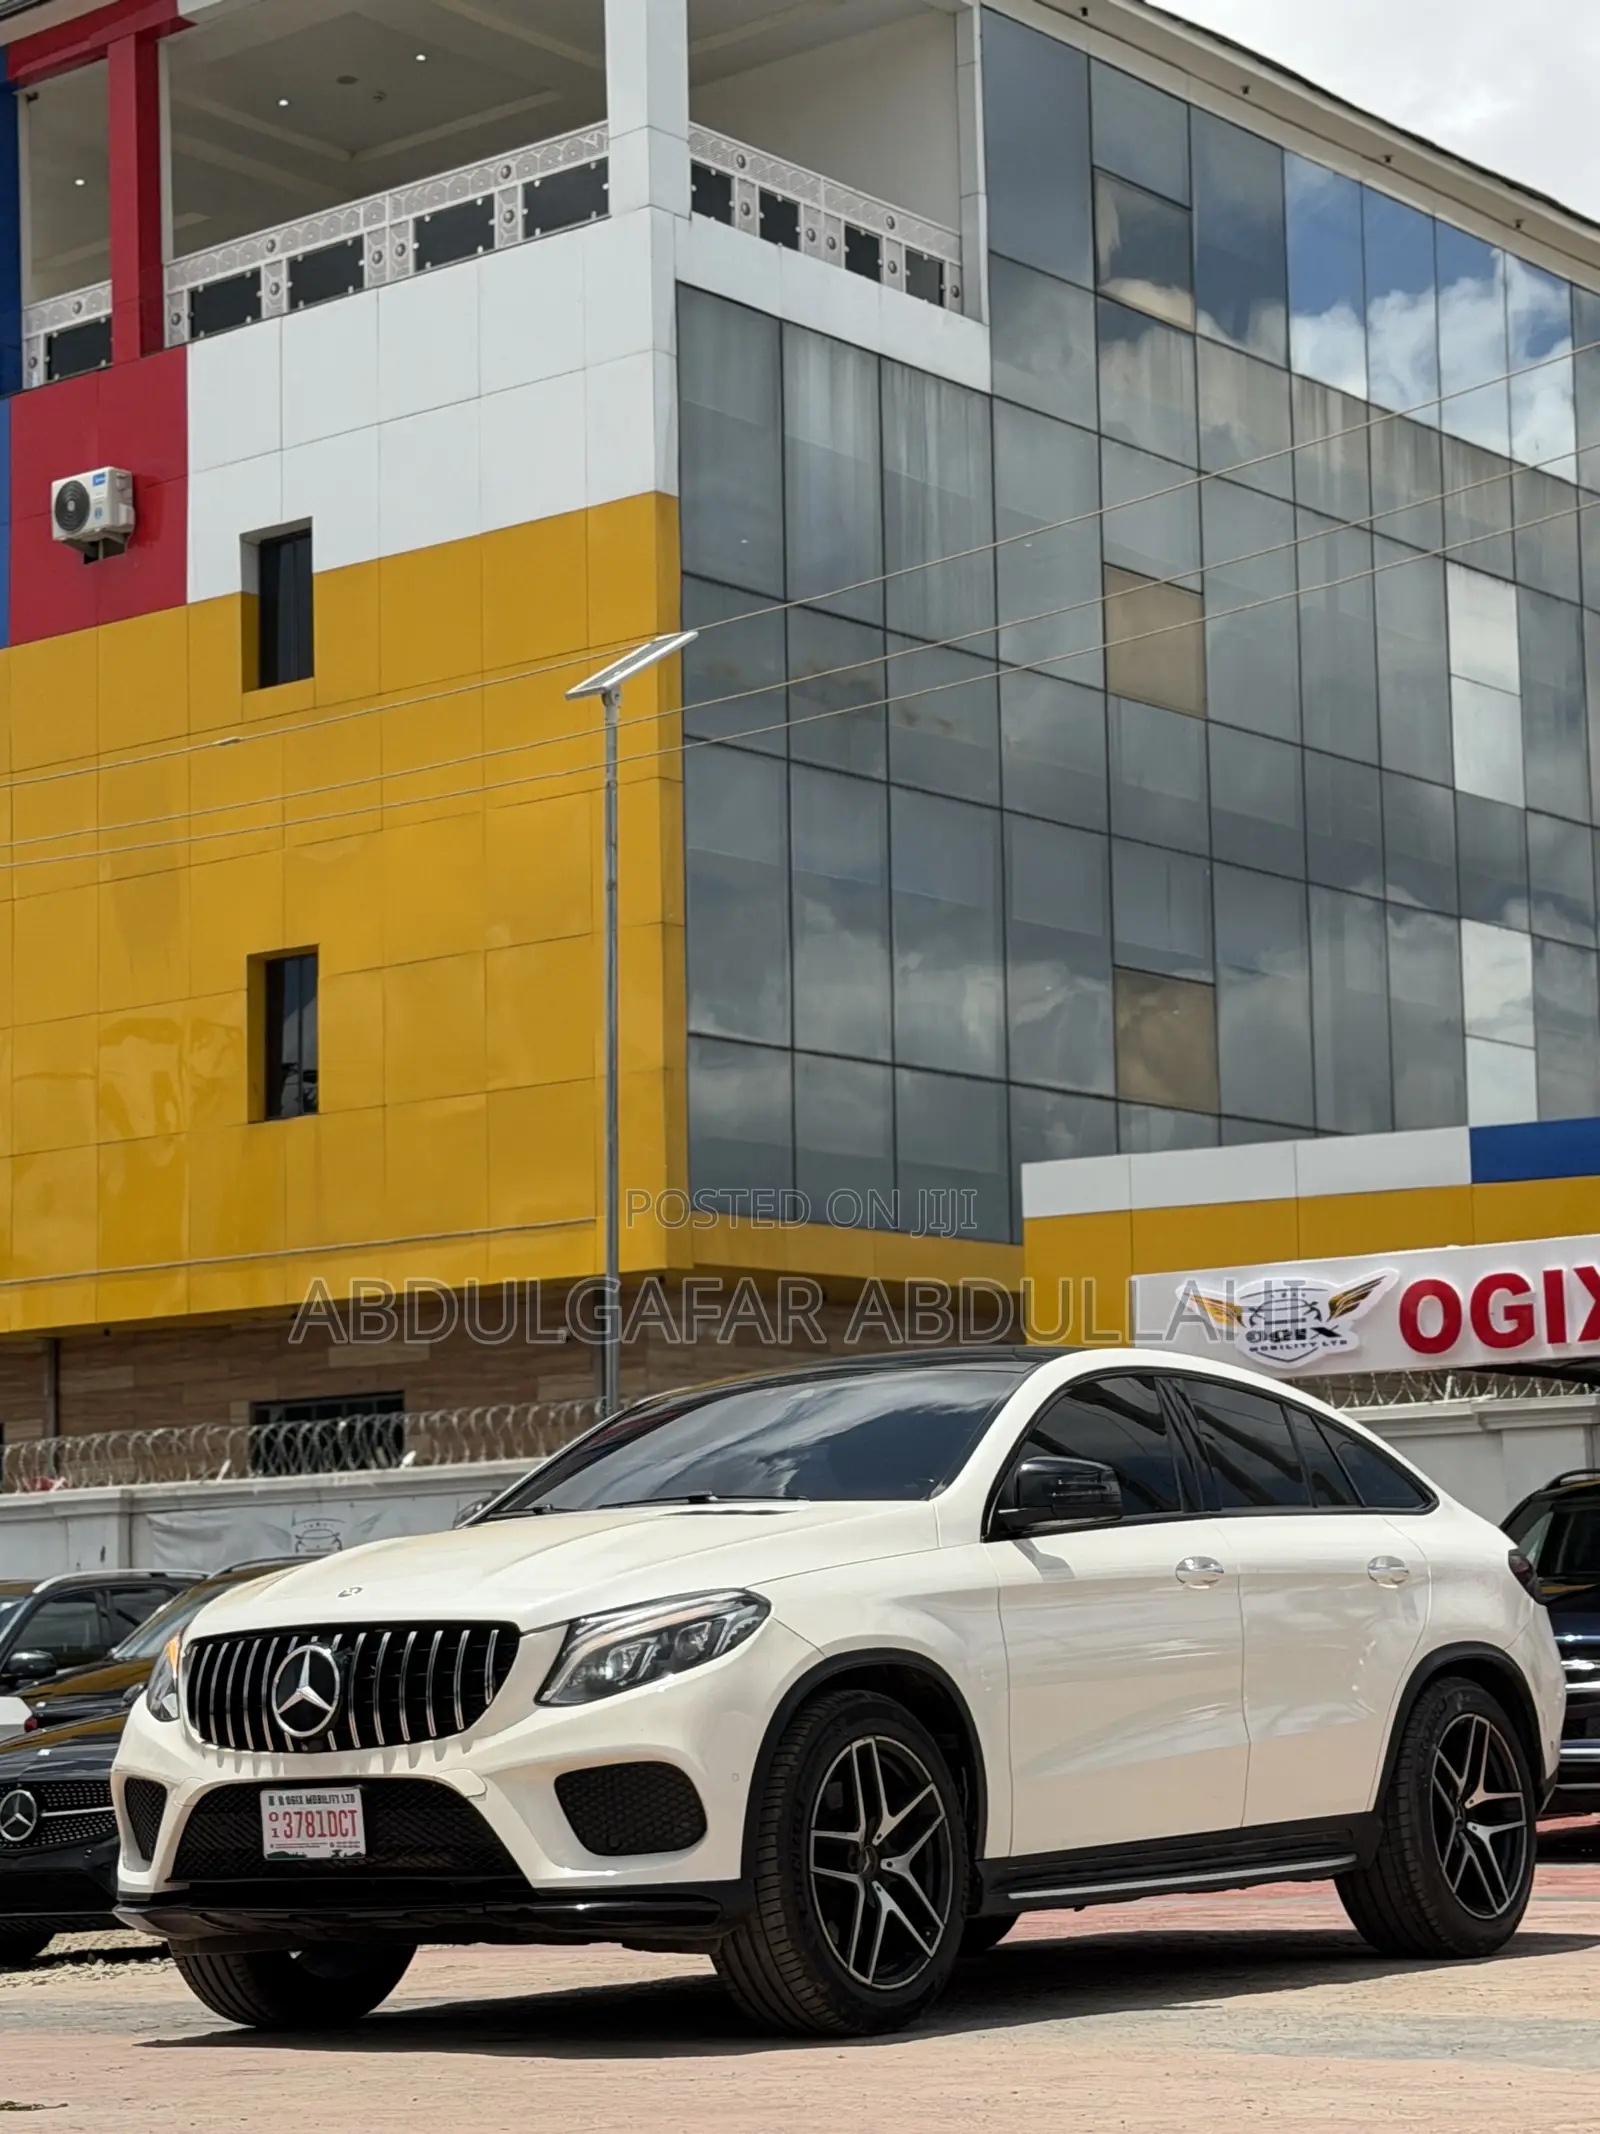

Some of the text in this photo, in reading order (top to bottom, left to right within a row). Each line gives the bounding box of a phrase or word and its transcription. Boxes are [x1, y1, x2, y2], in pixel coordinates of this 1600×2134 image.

[1248, 1339, 1348, 1353] MOBILITY LTD
[305, 1794, 340, 1805] MOBILITY
[340, 1793, 356, 1804] LTD
[282, 1809, 358, 1839] 3781DCT
